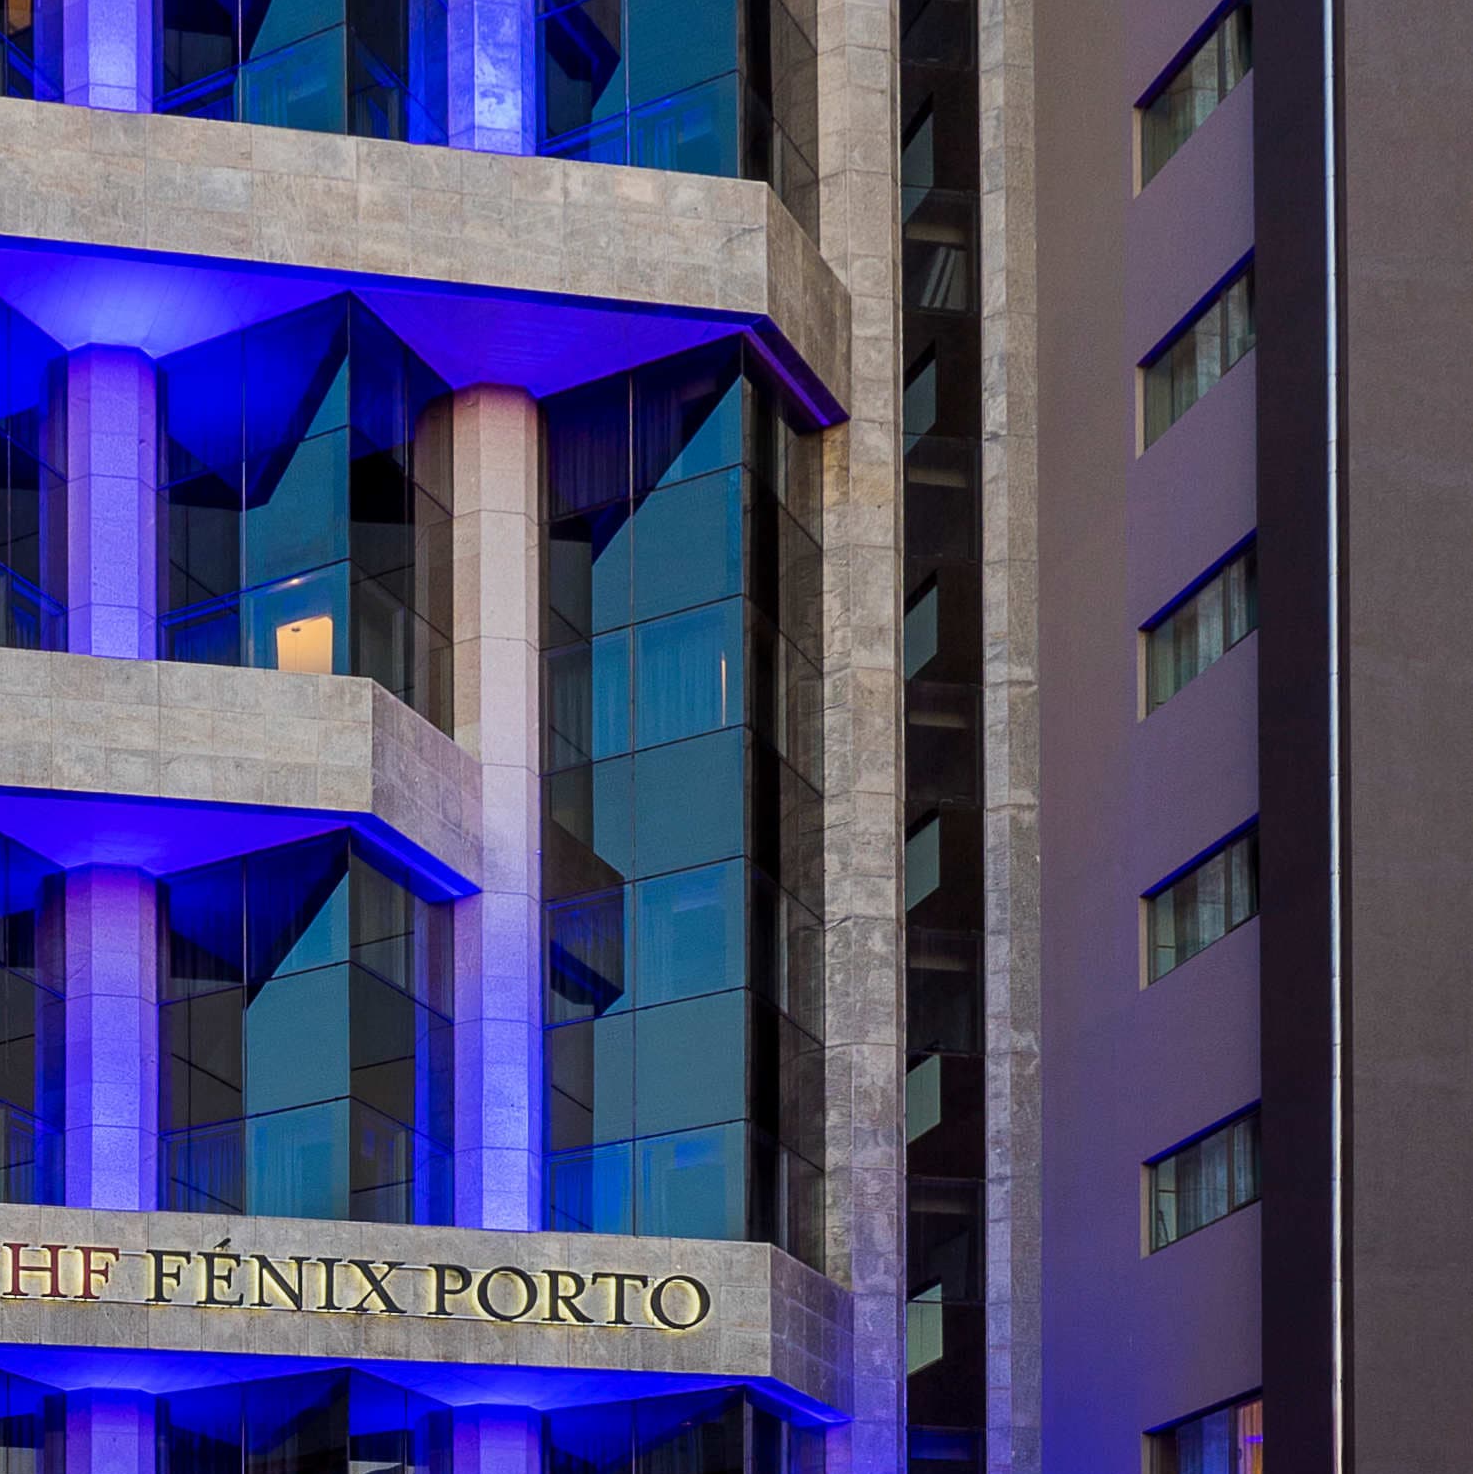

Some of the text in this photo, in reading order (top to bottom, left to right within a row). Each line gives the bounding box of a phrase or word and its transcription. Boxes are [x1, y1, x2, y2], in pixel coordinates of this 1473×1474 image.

[2, 1241, 712, 1331] HF FÉNIX PORTO
